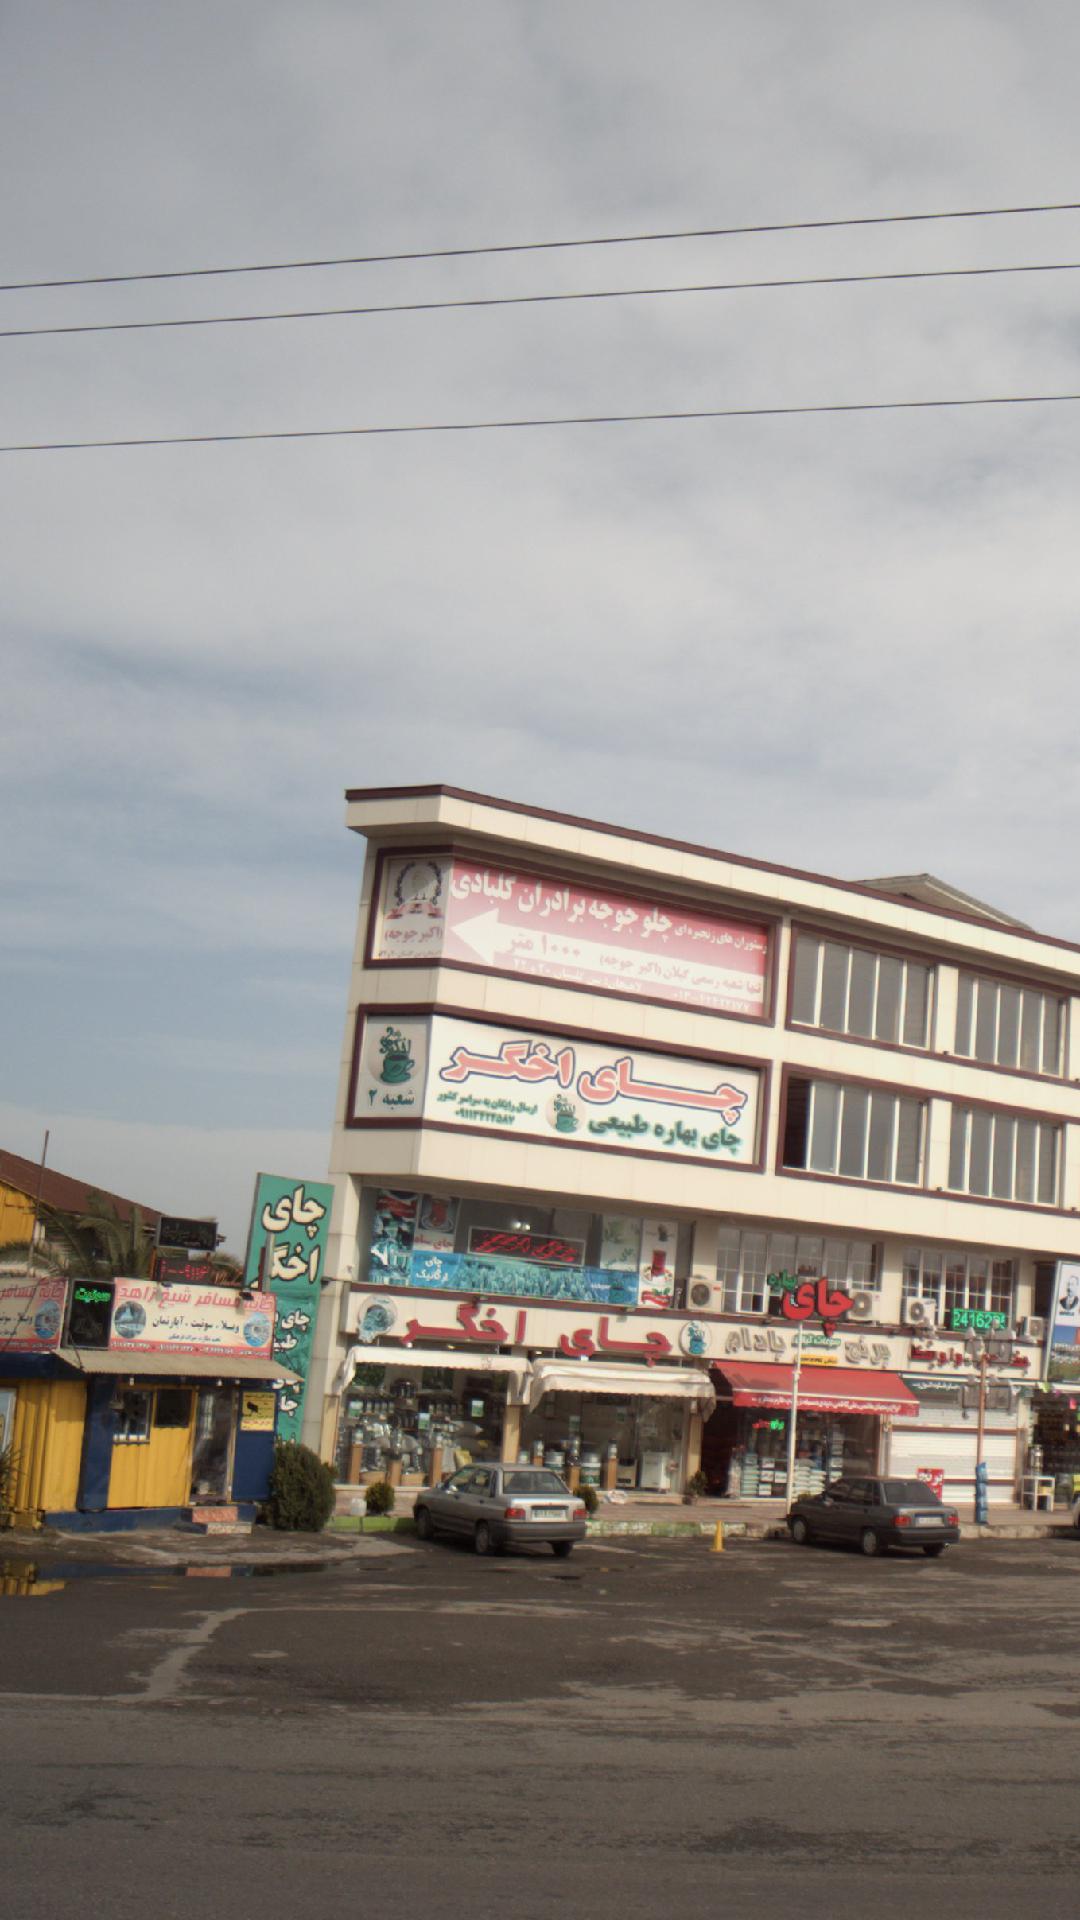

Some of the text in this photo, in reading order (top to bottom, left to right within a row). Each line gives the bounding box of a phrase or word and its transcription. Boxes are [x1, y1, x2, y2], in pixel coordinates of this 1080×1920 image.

[517, 880, 586, 923] برادران
[588, 899, 639, 934] جوجه
[640, 907, 672, 943] چلو
[382, 1089, 415, 1110] شعبه
[439, 1040, 748, 1126] چای اخگر
[587, 1114, 743, 1156] چای بهاره طبیعی
[262, 1184, 326, 1240] چای
[402, 1303, 527, 1346] اخگر
[783, 1275, 854, 1337] چای
[560, 1317, 672, 1367] چای
